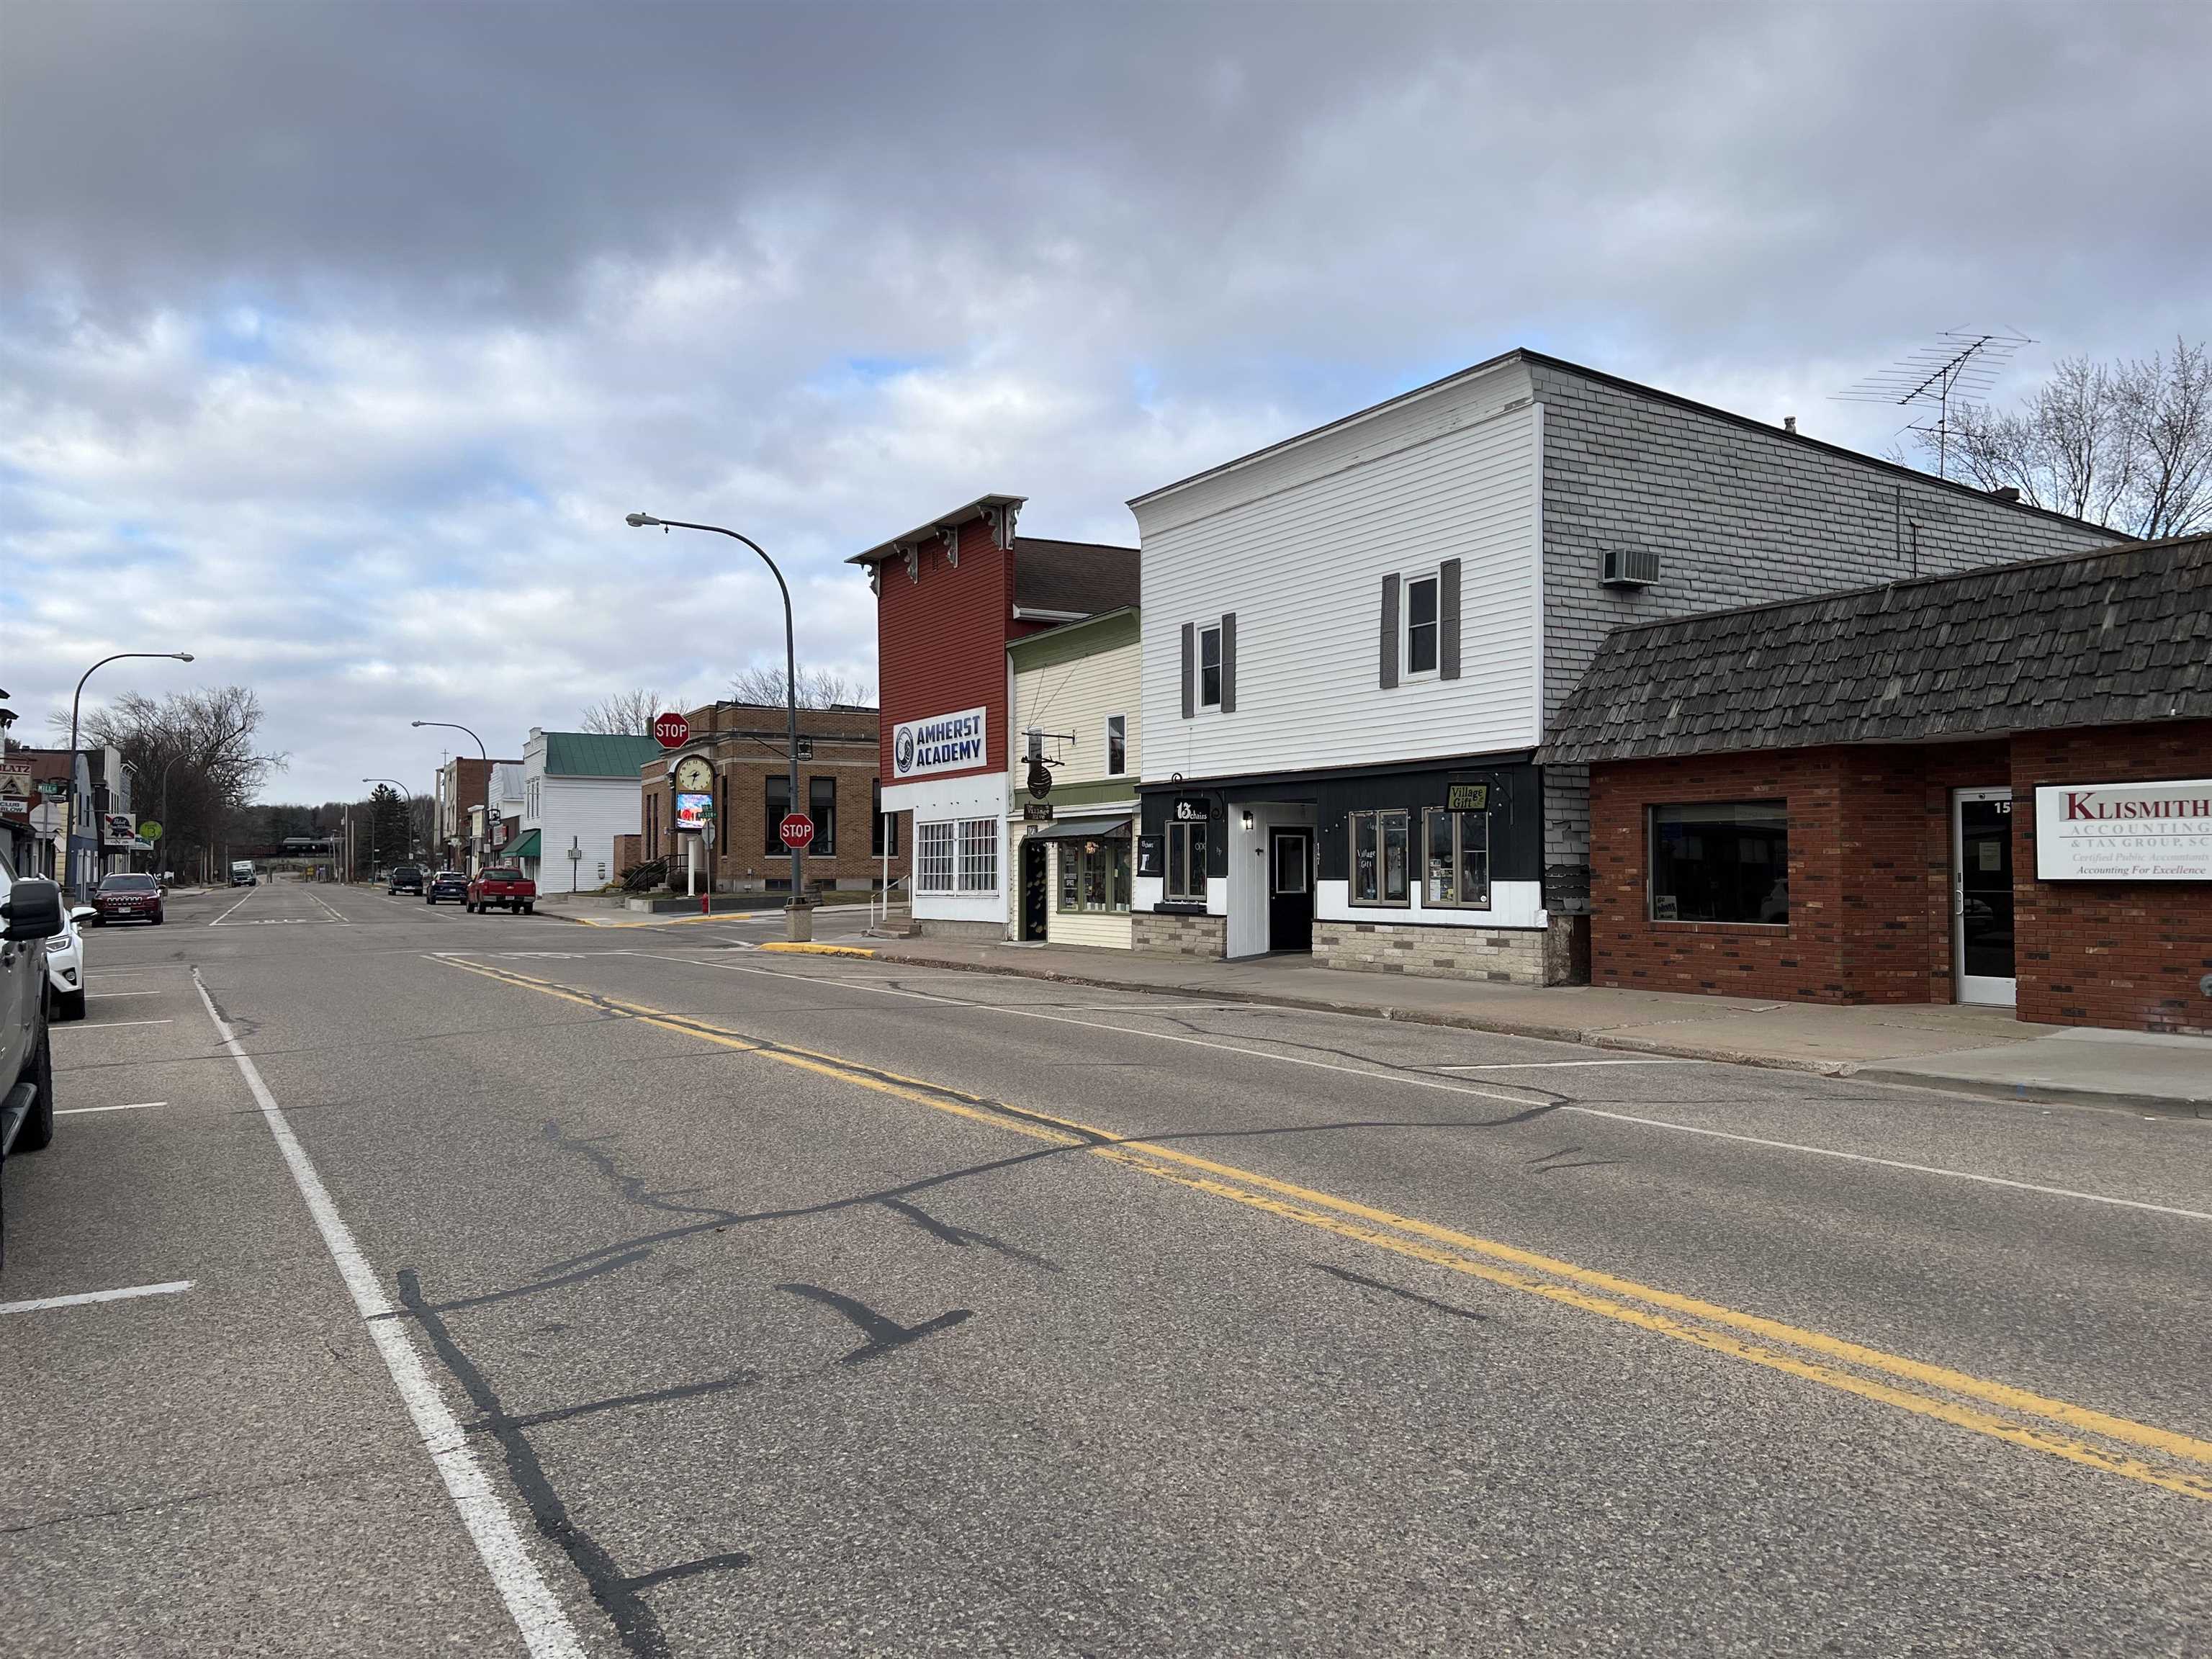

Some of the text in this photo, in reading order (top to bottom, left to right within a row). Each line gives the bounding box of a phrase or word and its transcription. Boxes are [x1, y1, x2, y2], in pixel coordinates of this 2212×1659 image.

[656, 724, 687, 737] STOP
[917, 715, 980, 745] AMHERST
[916, 738, 981, 767] ACADEMY
[0, 764, 30, 773] LATZ
[1452, 786, 1483, 801] Village
[1454, 797, 1472, 808] Gift
[2065, 792, 2211, 820] KLISMITH
[1027, 804, 1050, 816] Village
[1177, 801, 1208, 819] 13 chairs
[783, 824, 811, 837] STOP
[2071, 822, 2209, 835] ACCOUNTING
[2071, 839, 2080, 848] &
[2087, 838, 2116, 848] TAX
[2188, 837, 2209, 847] SC
[1357, 849, 1376, 858] Village
[2072, 853, 2210, 862] Certified Public Accountants
[2077, 866, 2206, 876] Accounting For Excellence
